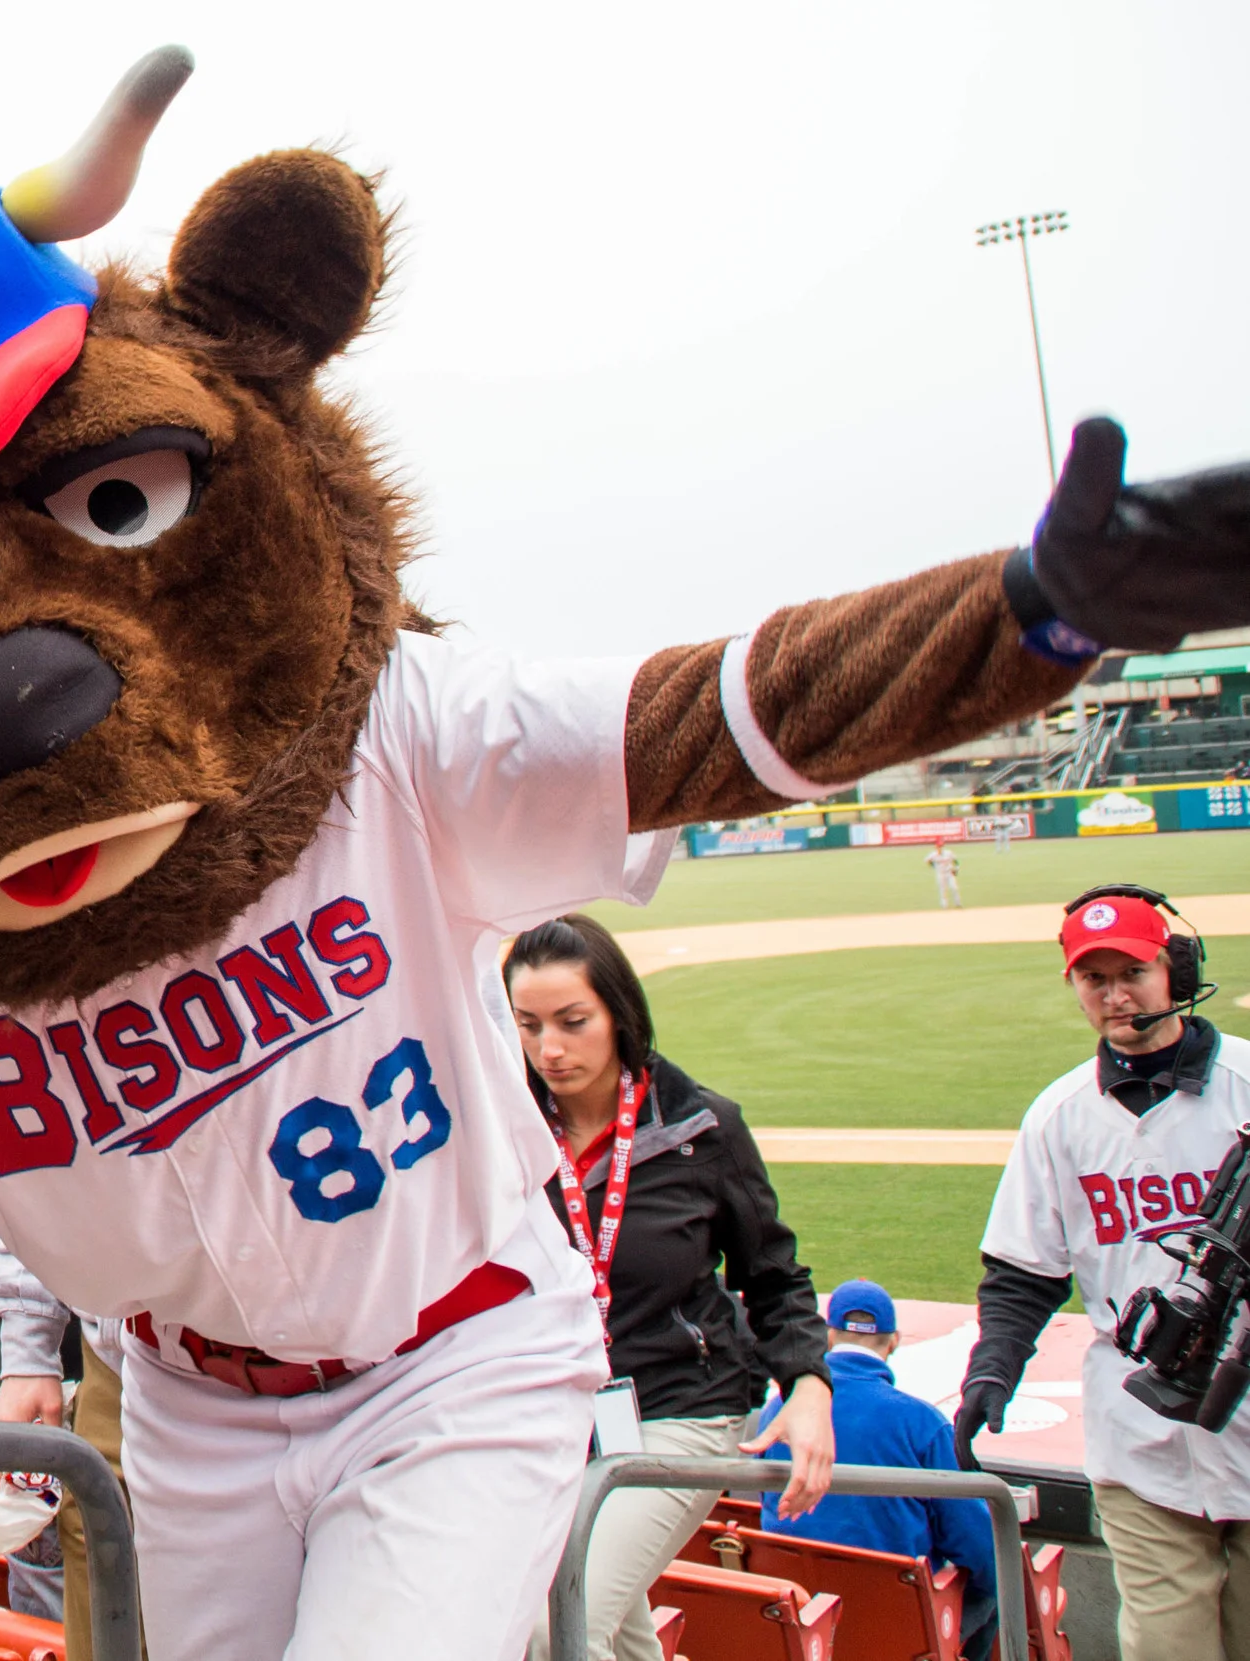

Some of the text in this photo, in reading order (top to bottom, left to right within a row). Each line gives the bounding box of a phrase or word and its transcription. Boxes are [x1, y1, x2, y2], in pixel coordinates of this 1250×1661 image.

[269, 1037, 452, 1224] 83
[614, 1137, 632, 1183] BISONS
[1078, 1170, 1218, 1246] BISO
[597, 1216, 620, 1262] BISONS
